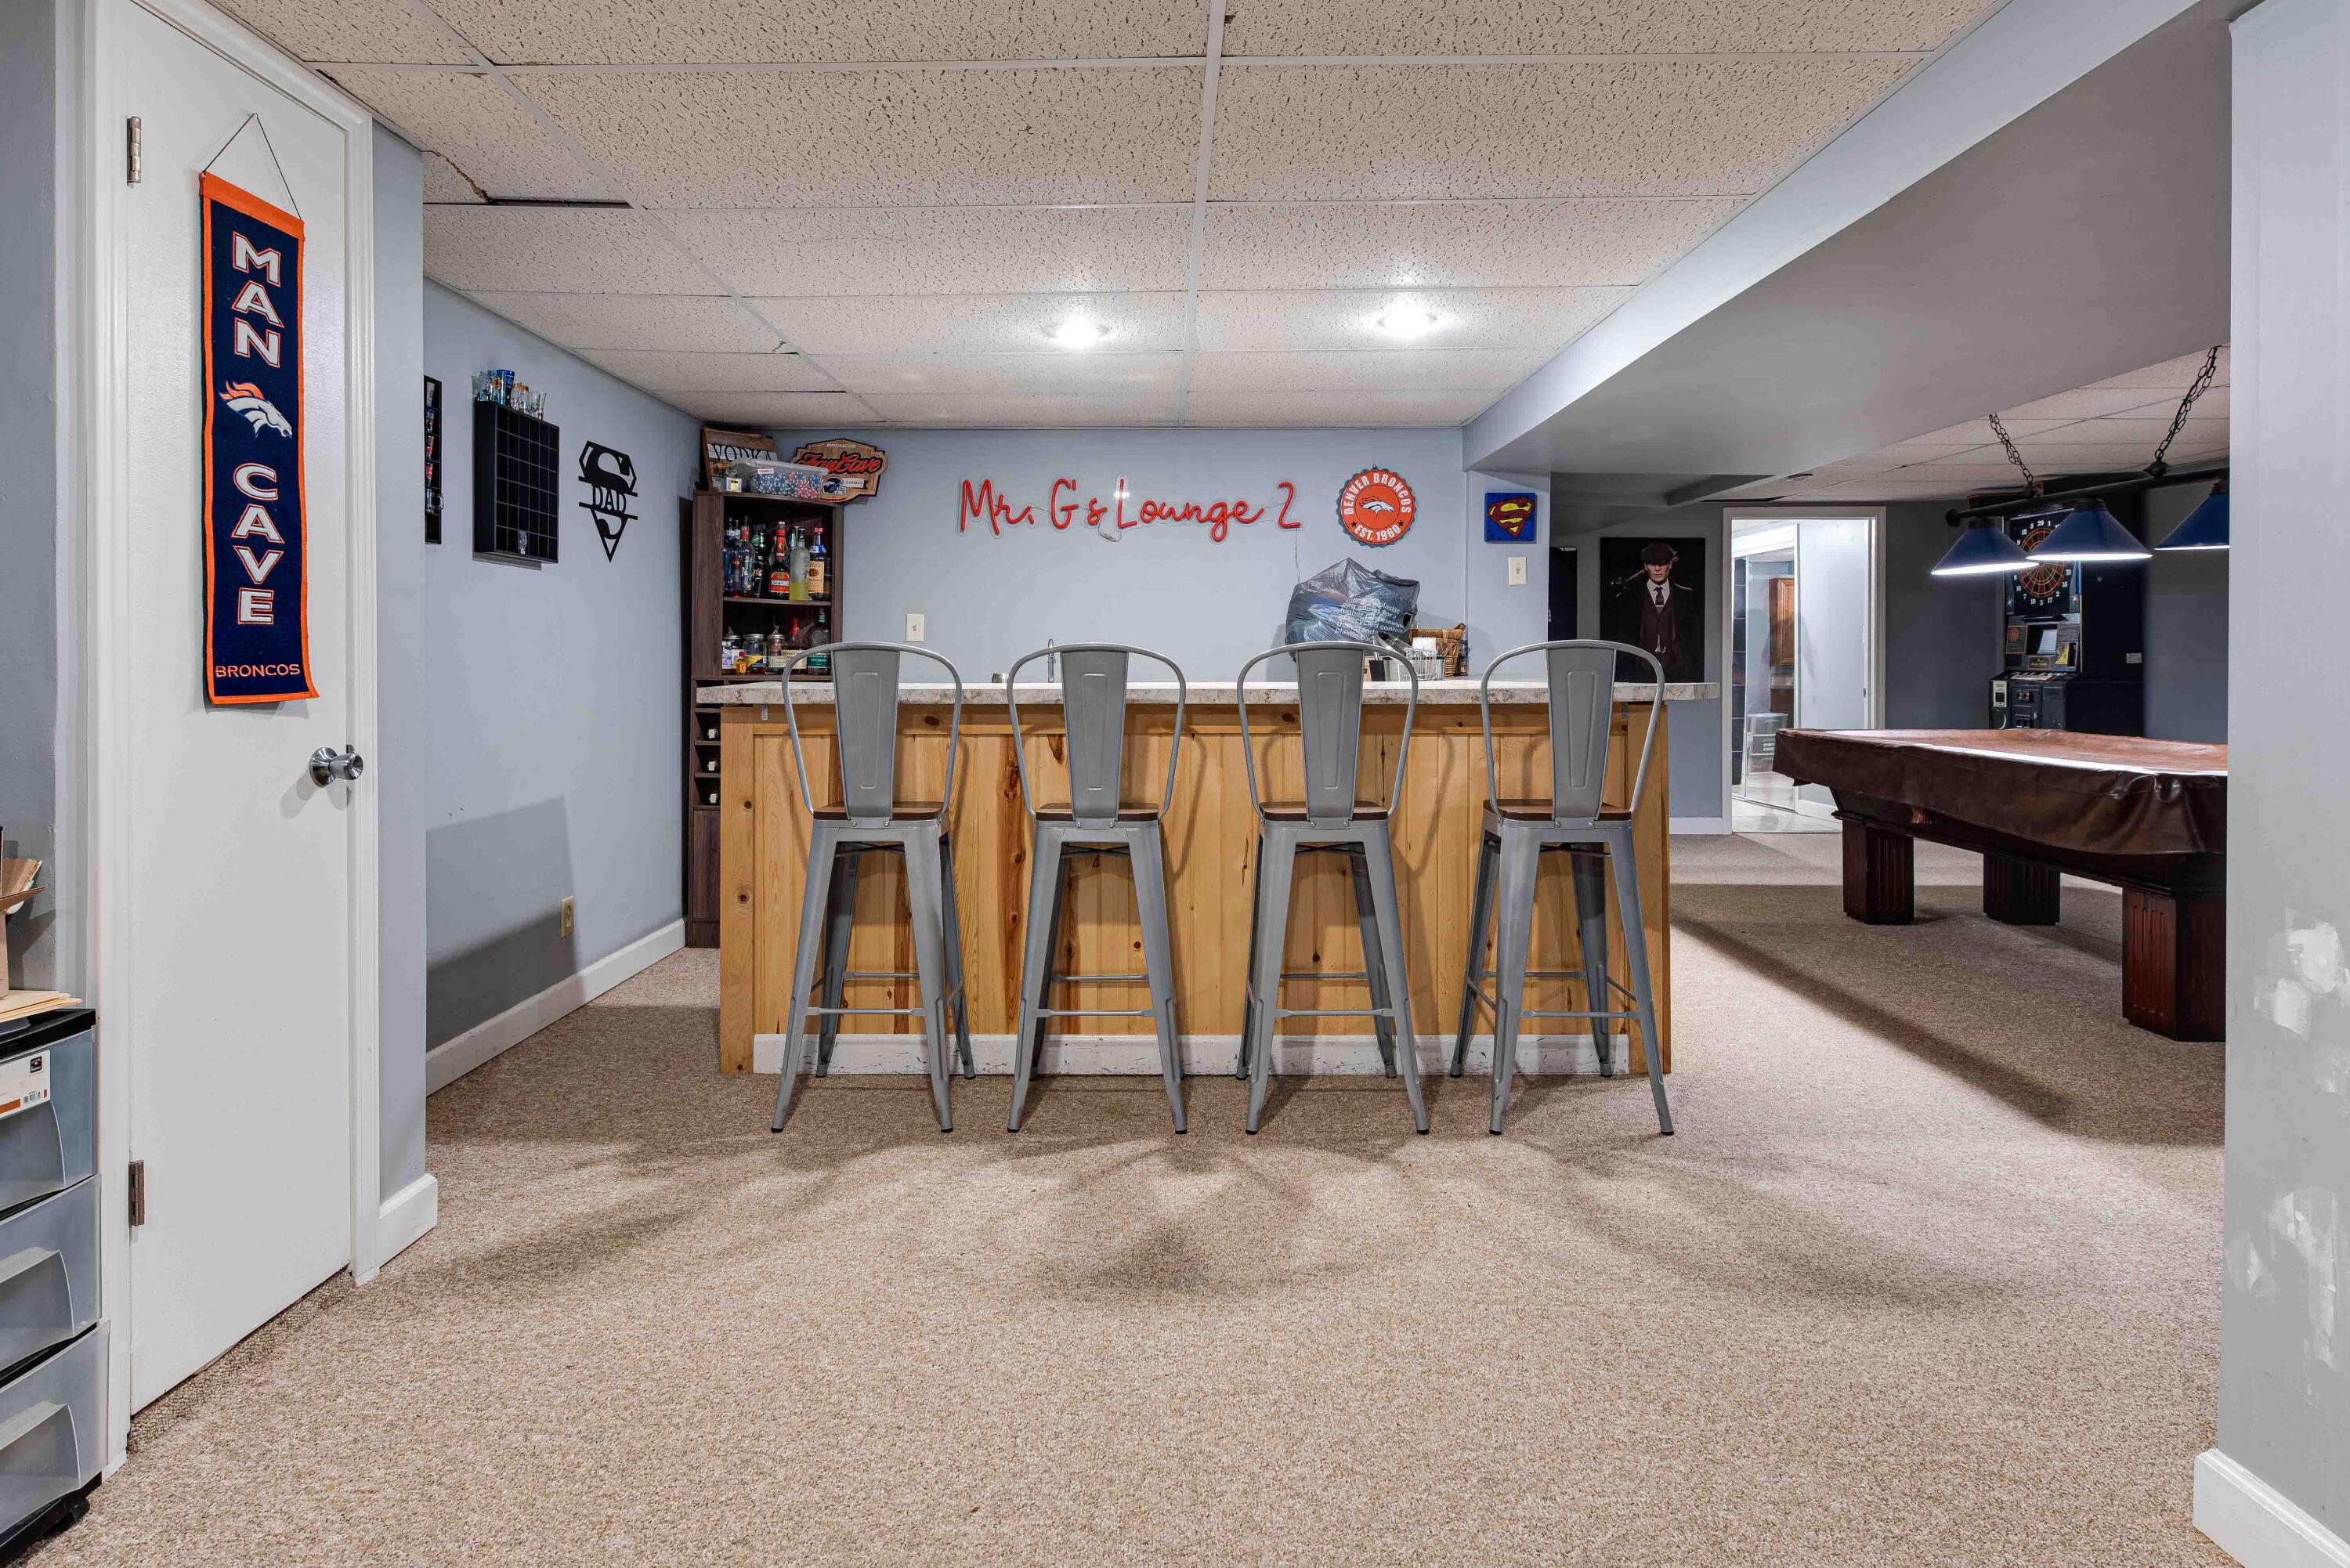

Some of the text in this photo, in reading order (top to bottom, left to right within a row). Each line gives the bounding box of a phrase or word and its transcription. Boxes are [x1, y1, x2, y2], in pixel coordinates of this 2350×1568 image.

[233, 230, 284, 367] MAN
[713, 444, 772, 461] VODKA
[592, 483, 627, 514] DAD
[960, 479, 1035, 535] Mr.
[1117, 479, 1264, 542] Lounge
[1278, 481, 1301, 528] 2
[1343, 472, 1412, 515] DENVER BRONCOS
[231, 463, 284, 625] CAVE
[1354, 524, 1401, 541] EST. 1960
[215, 662, 301, 680] BRONCOS
